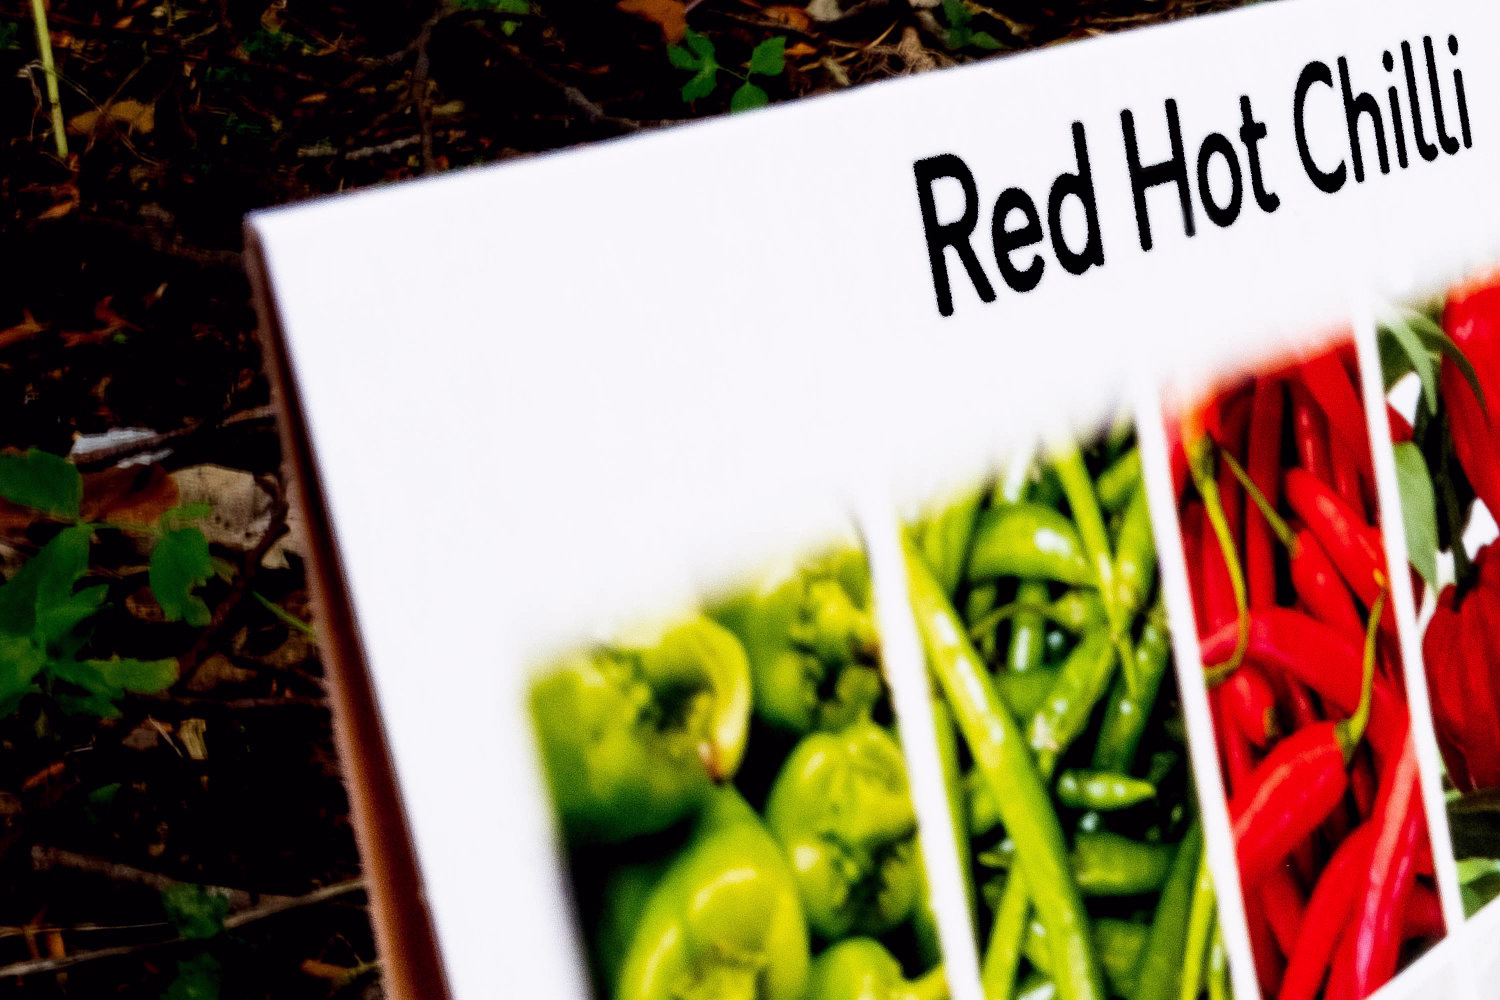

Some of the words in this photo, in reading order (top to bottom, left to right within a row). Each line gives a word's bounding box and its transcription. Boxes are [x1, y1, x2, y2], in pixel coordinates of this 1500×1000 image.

[913, 119, 1105, 318] Red
[1119, 94, 1281, 252] Hot
[1293, 33, 1473, 194] Chilli
